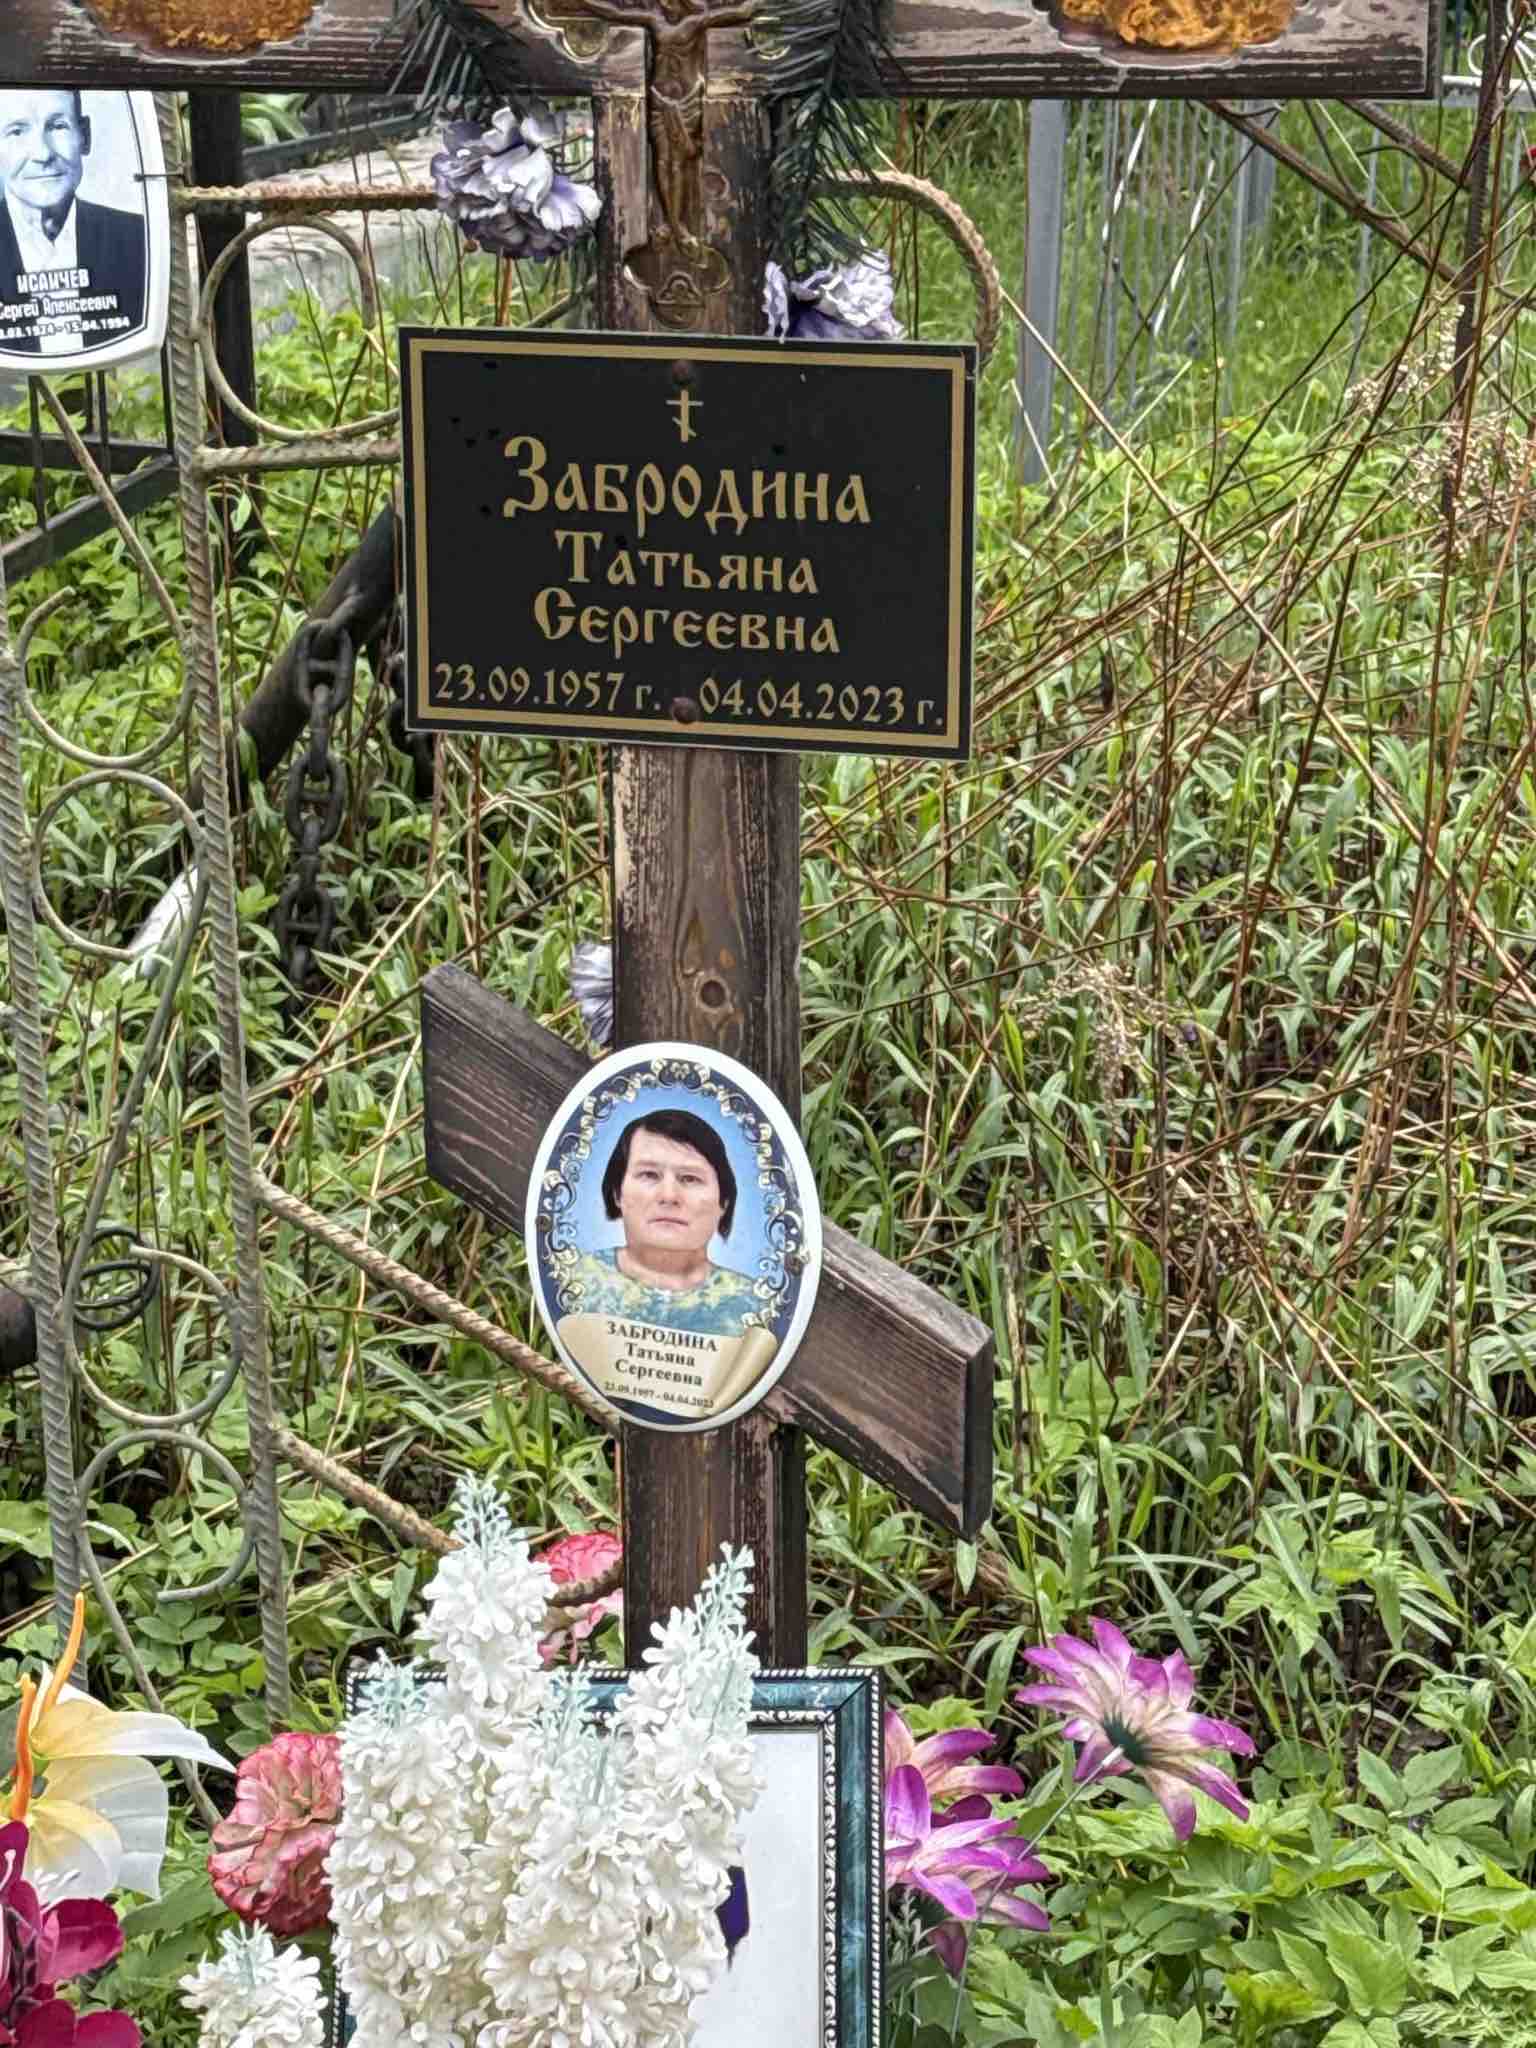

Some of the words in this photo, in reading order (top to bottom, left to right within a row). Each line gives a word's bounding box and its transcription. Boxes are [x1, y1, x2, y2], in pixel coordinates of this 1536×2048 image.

[16, 268, 89, 293] ИСАИЧЕВ
[42, 295, 118, 316] Алексеевич
[503, 436, 871, 539] Забродина
[554, 529, 818, 594] Татьяна
[534, 587, 840, 659] Сергеевна
[435, 663, 625, 712] 23.09.1957
[635, 685, 662, 711] г.
[699, 677, 905, 725] 04.04.2023
[917, 700, 943, 726] г.
[606, 1320, 719, 1353] ЗАБРОДИНА
[624, 1342, 696, 1368] Татьяна
[614, 1358, 703, 1387] Сергеевна
